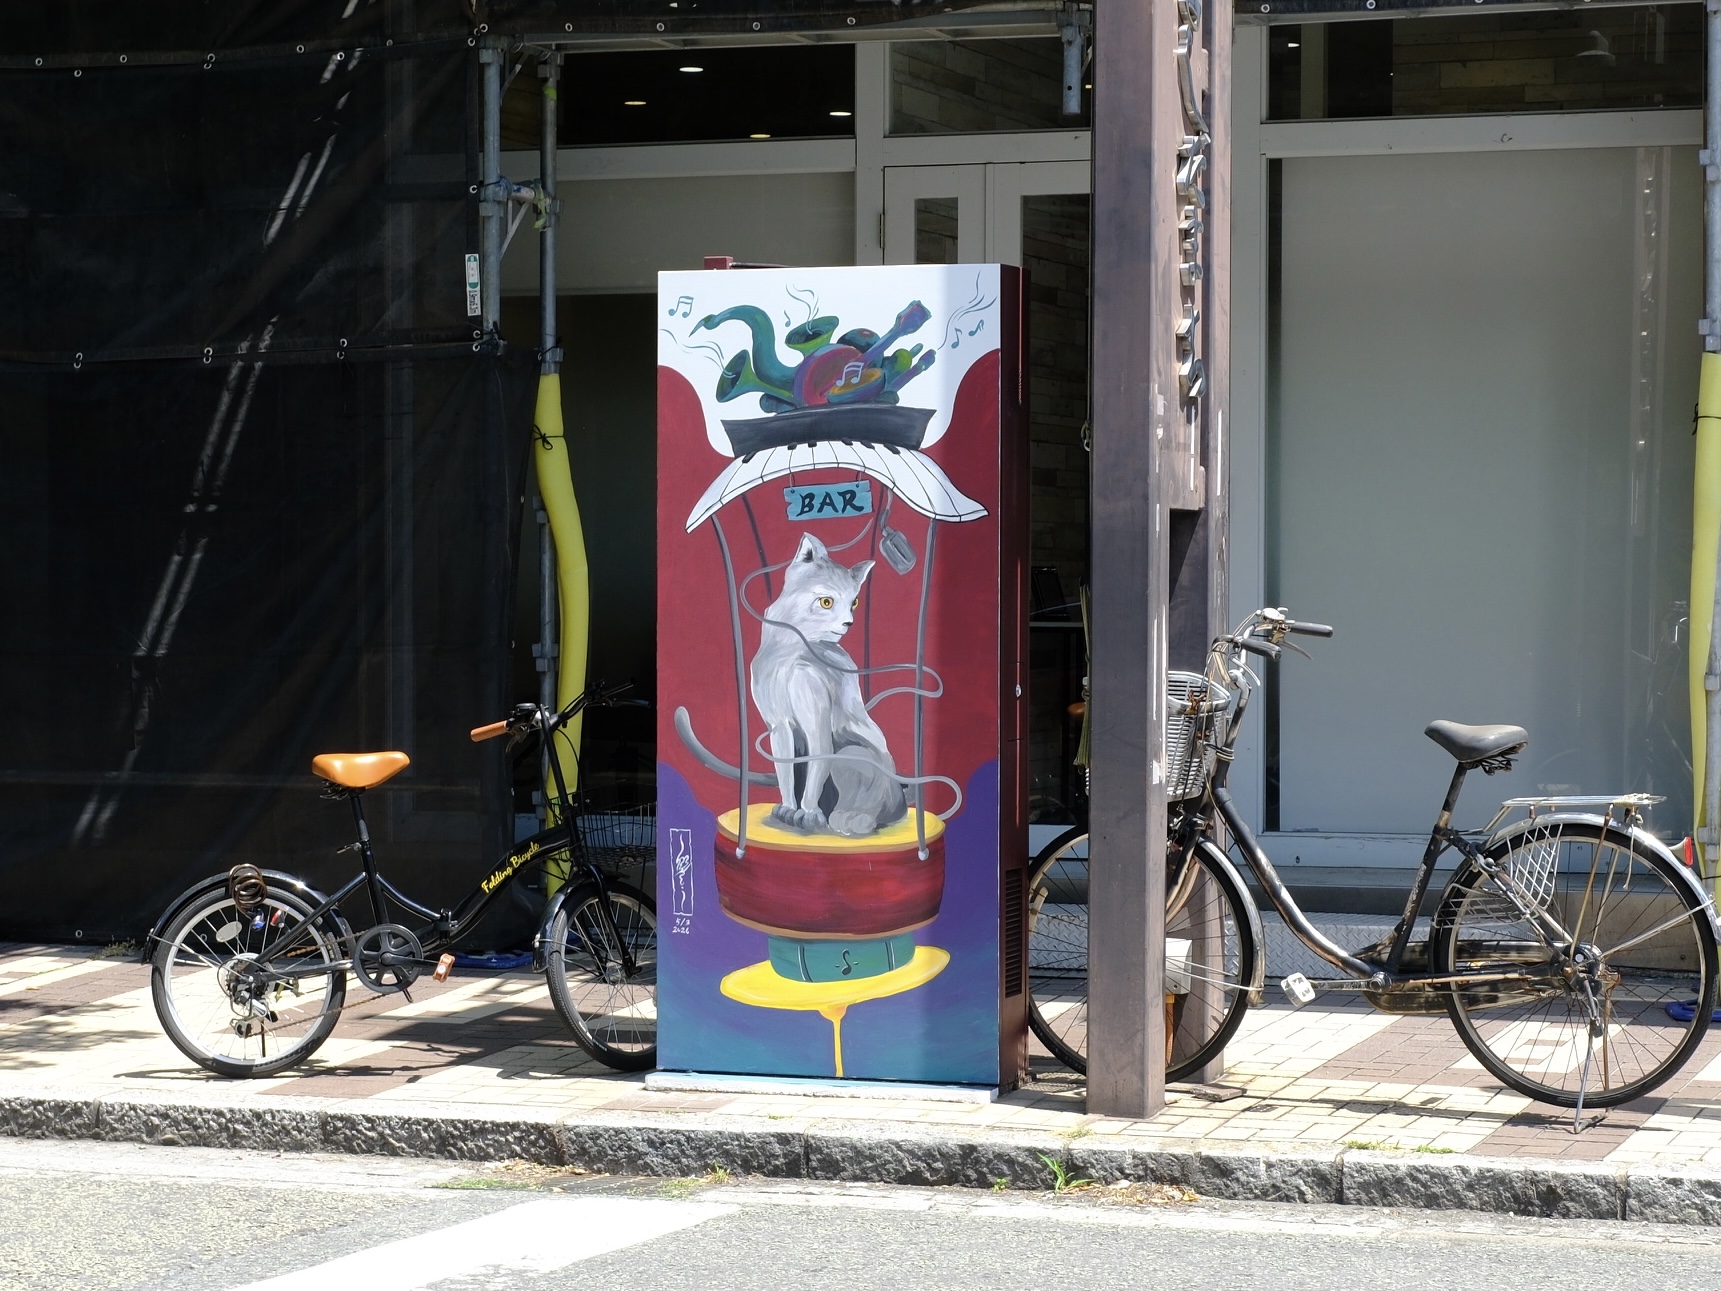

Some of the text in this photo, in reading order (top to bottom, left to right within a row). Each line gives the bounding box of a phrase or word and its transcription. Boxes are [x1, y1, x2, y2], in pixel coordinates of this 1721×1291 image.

[796, 489, 865, 517] BAR
[481, 841, 540, 893] Folding Bicycle
